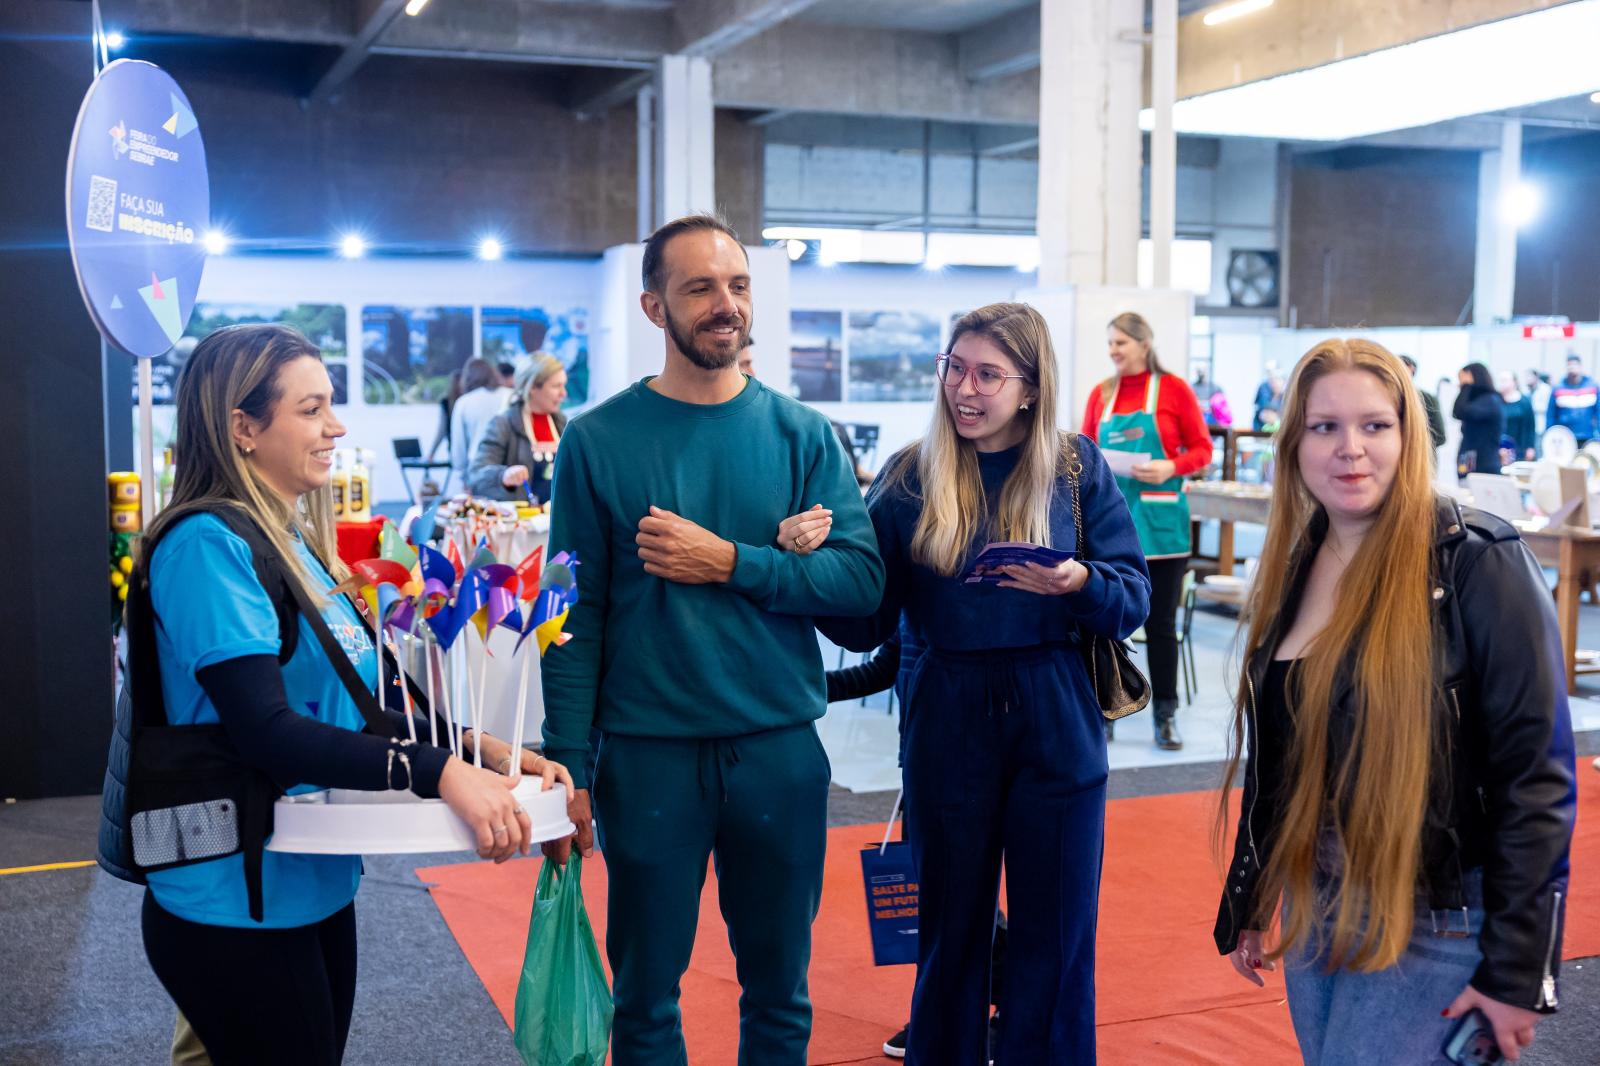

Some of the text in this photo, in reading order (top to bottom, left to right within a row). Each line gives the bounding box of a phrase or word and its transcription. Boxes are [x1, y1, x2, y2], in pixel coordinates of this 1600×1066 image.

[120, 193, 164, 217] FAÇA SUA
[873, 884, 905, 896] SALTE
[874, 898, 893, 907] UM
